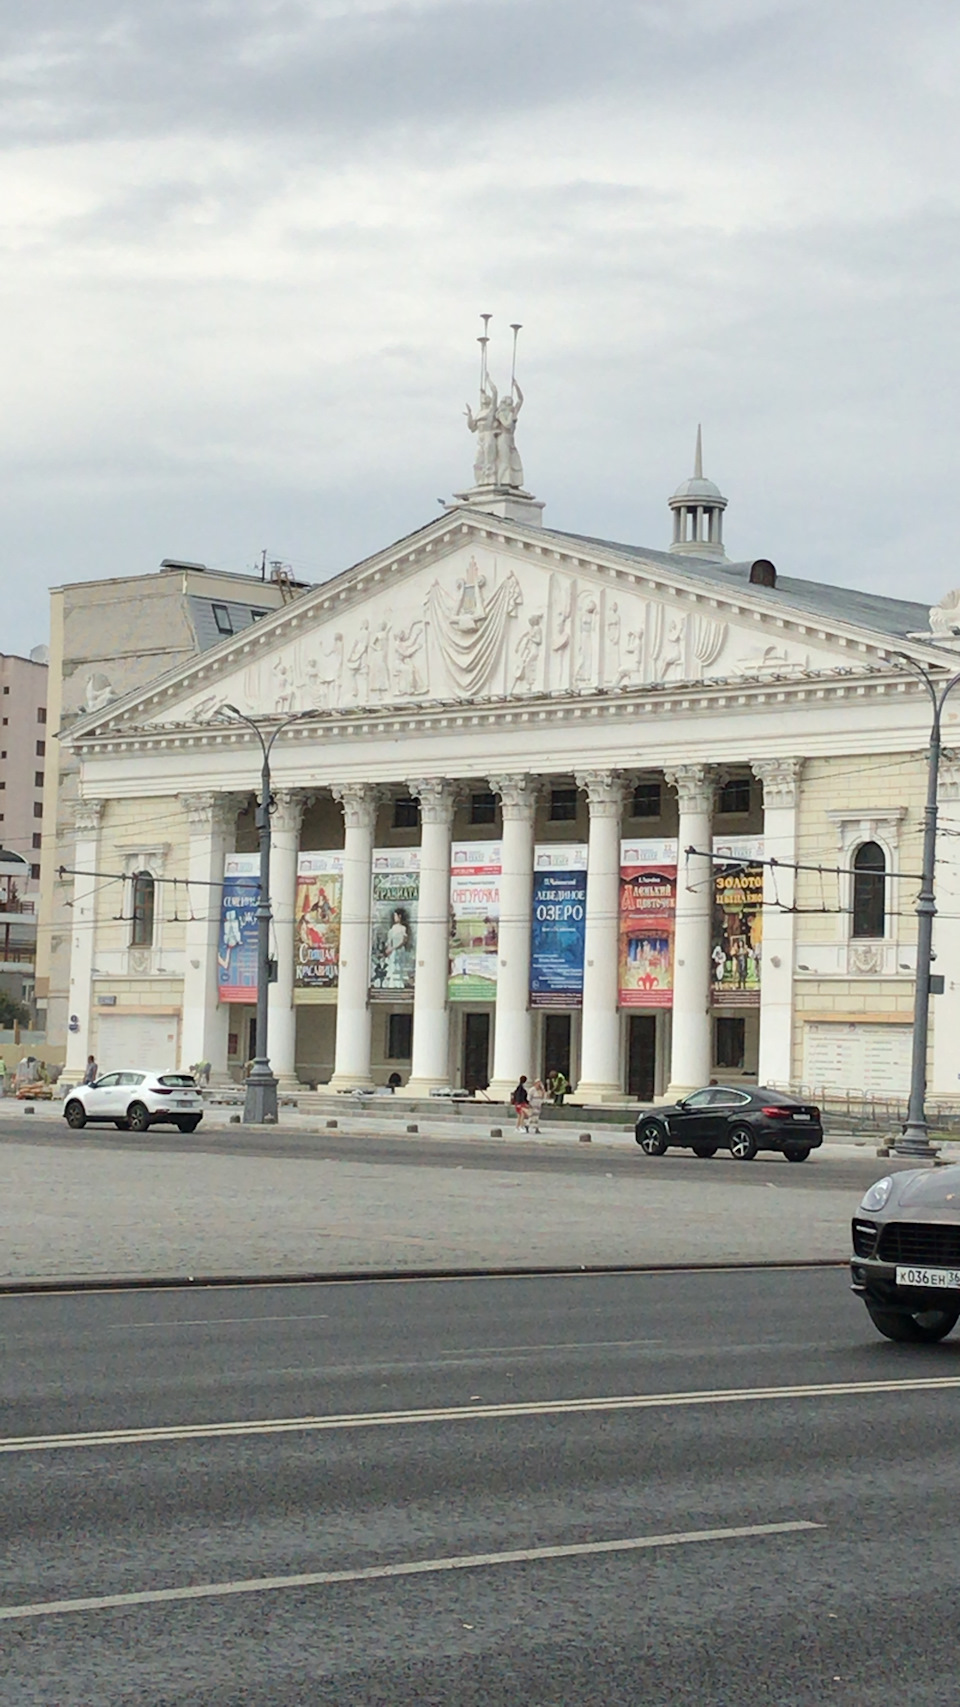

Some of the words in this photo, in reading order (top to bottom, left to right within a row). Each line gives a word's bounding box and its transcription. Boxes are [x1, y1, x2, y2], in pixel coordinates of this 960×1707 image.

[716, 876, 763, 889] ЗОЛОТО
[452, 888, 500, 903] СНЕГУРОЧКА
[535, 890, 585, 902] ЛЕБЕДИНОЕ
[536, 905, 583, 921] ОЗЕРО
